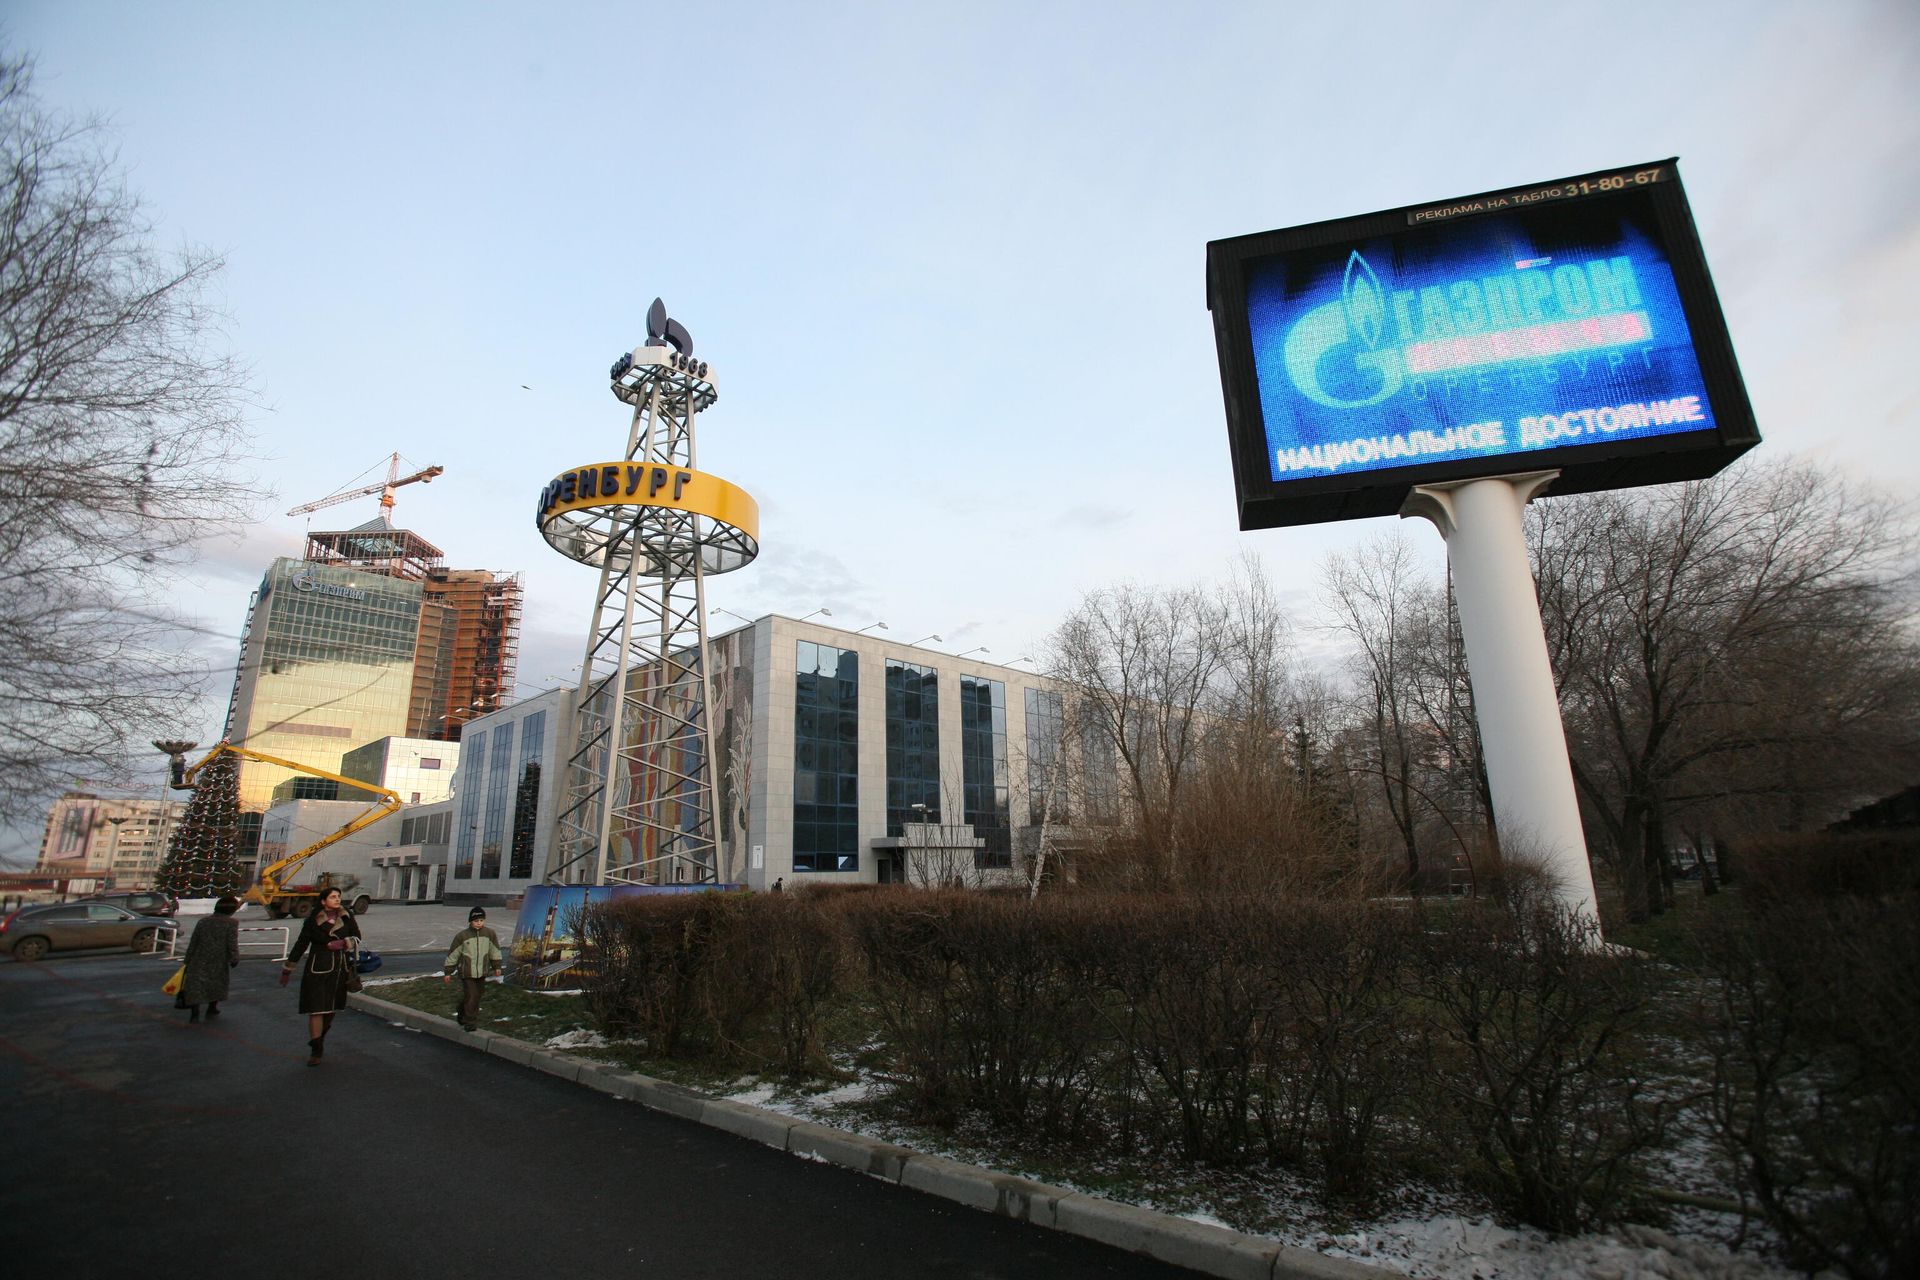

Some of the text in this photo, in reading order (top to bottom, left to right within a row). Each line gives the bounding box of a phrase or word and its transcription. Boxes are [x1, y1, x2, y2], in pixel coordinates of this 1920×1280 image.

[1415, 168, 1662, 221] РЕКЛАМА НА ТАБЛО 31-80-67
[1391, 256, 1643, 341] ГАЗПРОМ
[670, 351, 708, 378] 1968
[1411, 347, 1654, 400] ОРЕНБУРГ
[1276, 396, 1705, 472] НАЦИОНАЛЬНОЕ ДОСТОЯНИЕ
